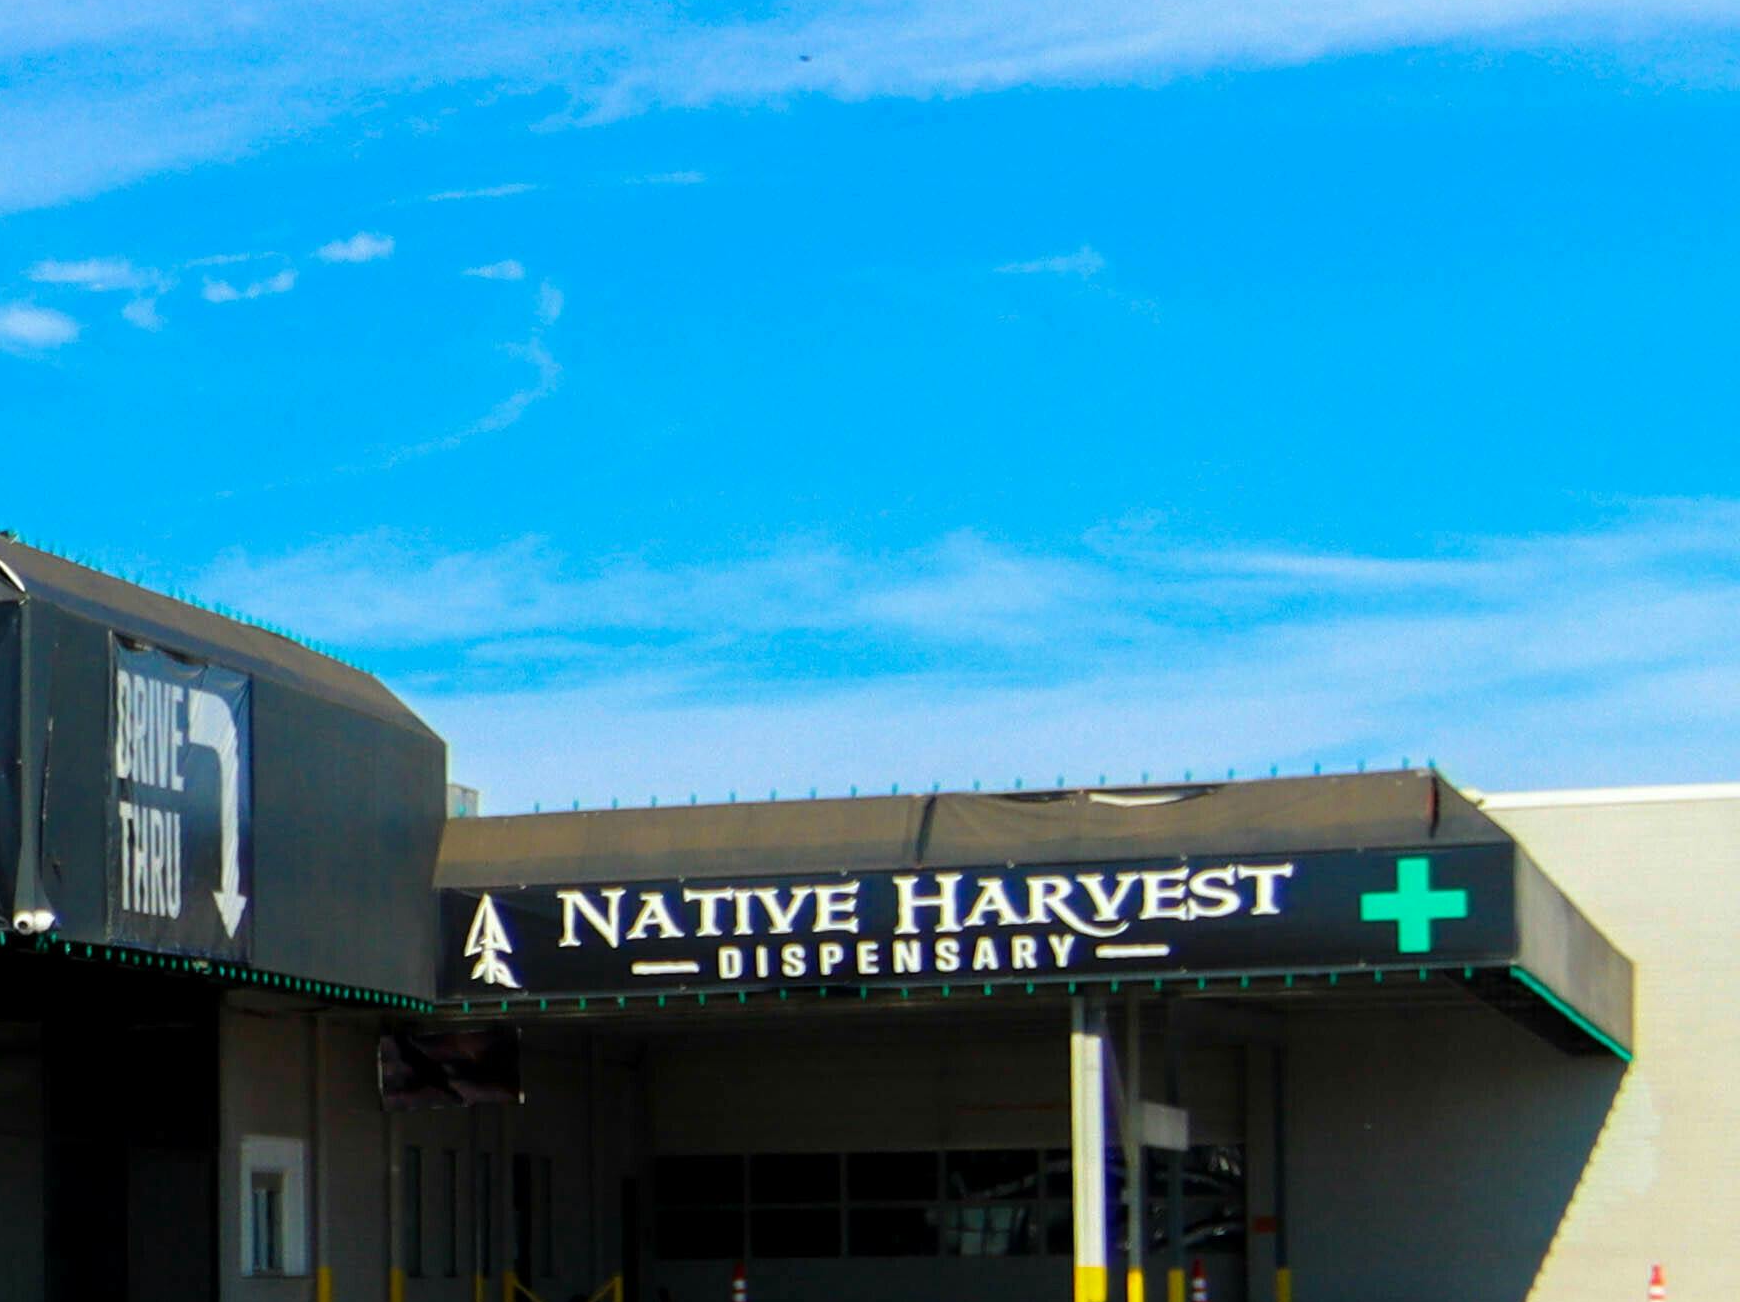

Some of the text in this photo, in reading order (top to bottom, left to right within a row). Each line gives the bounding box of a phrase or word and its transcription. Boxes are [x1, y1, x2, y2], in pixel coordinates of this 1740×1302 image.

[115, 667, 184, 792] DRIVE
[119, 800, 181, 919] THRU
[557, 863, 1294, 951] NATIVE HARVEST
[718, 934, 1078, 981] DISPENSARY
